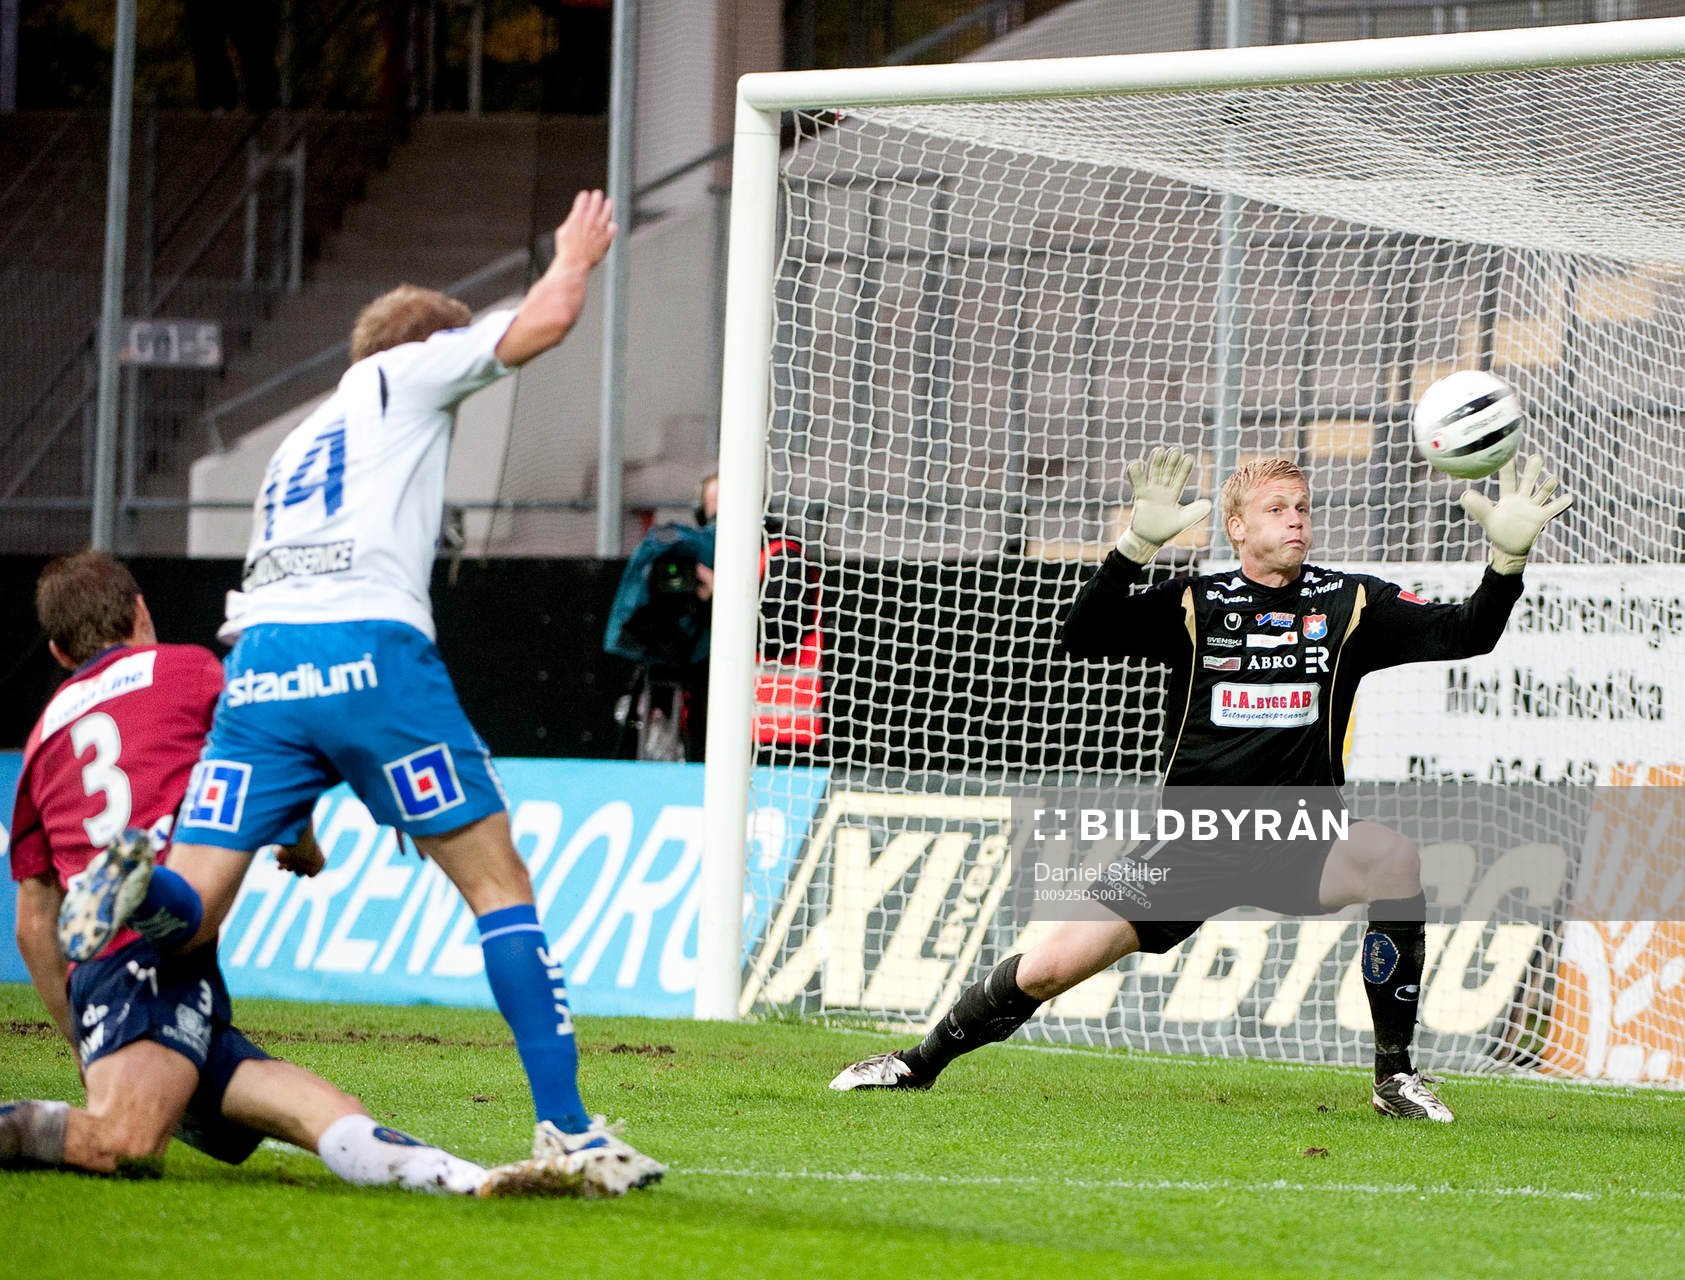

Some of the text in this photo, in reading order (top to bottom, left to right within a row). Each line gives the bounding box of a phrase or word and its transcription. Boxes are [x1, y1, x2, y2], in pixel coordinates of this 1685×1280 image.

[227, 654, 378, 708] stadium
[1247, 655, 1297, 670] ÅBRO
[1290, 691, 1312, 709] AB
[70, 711, 132, 848] 3
[757, 827, 974, 1010] XL
